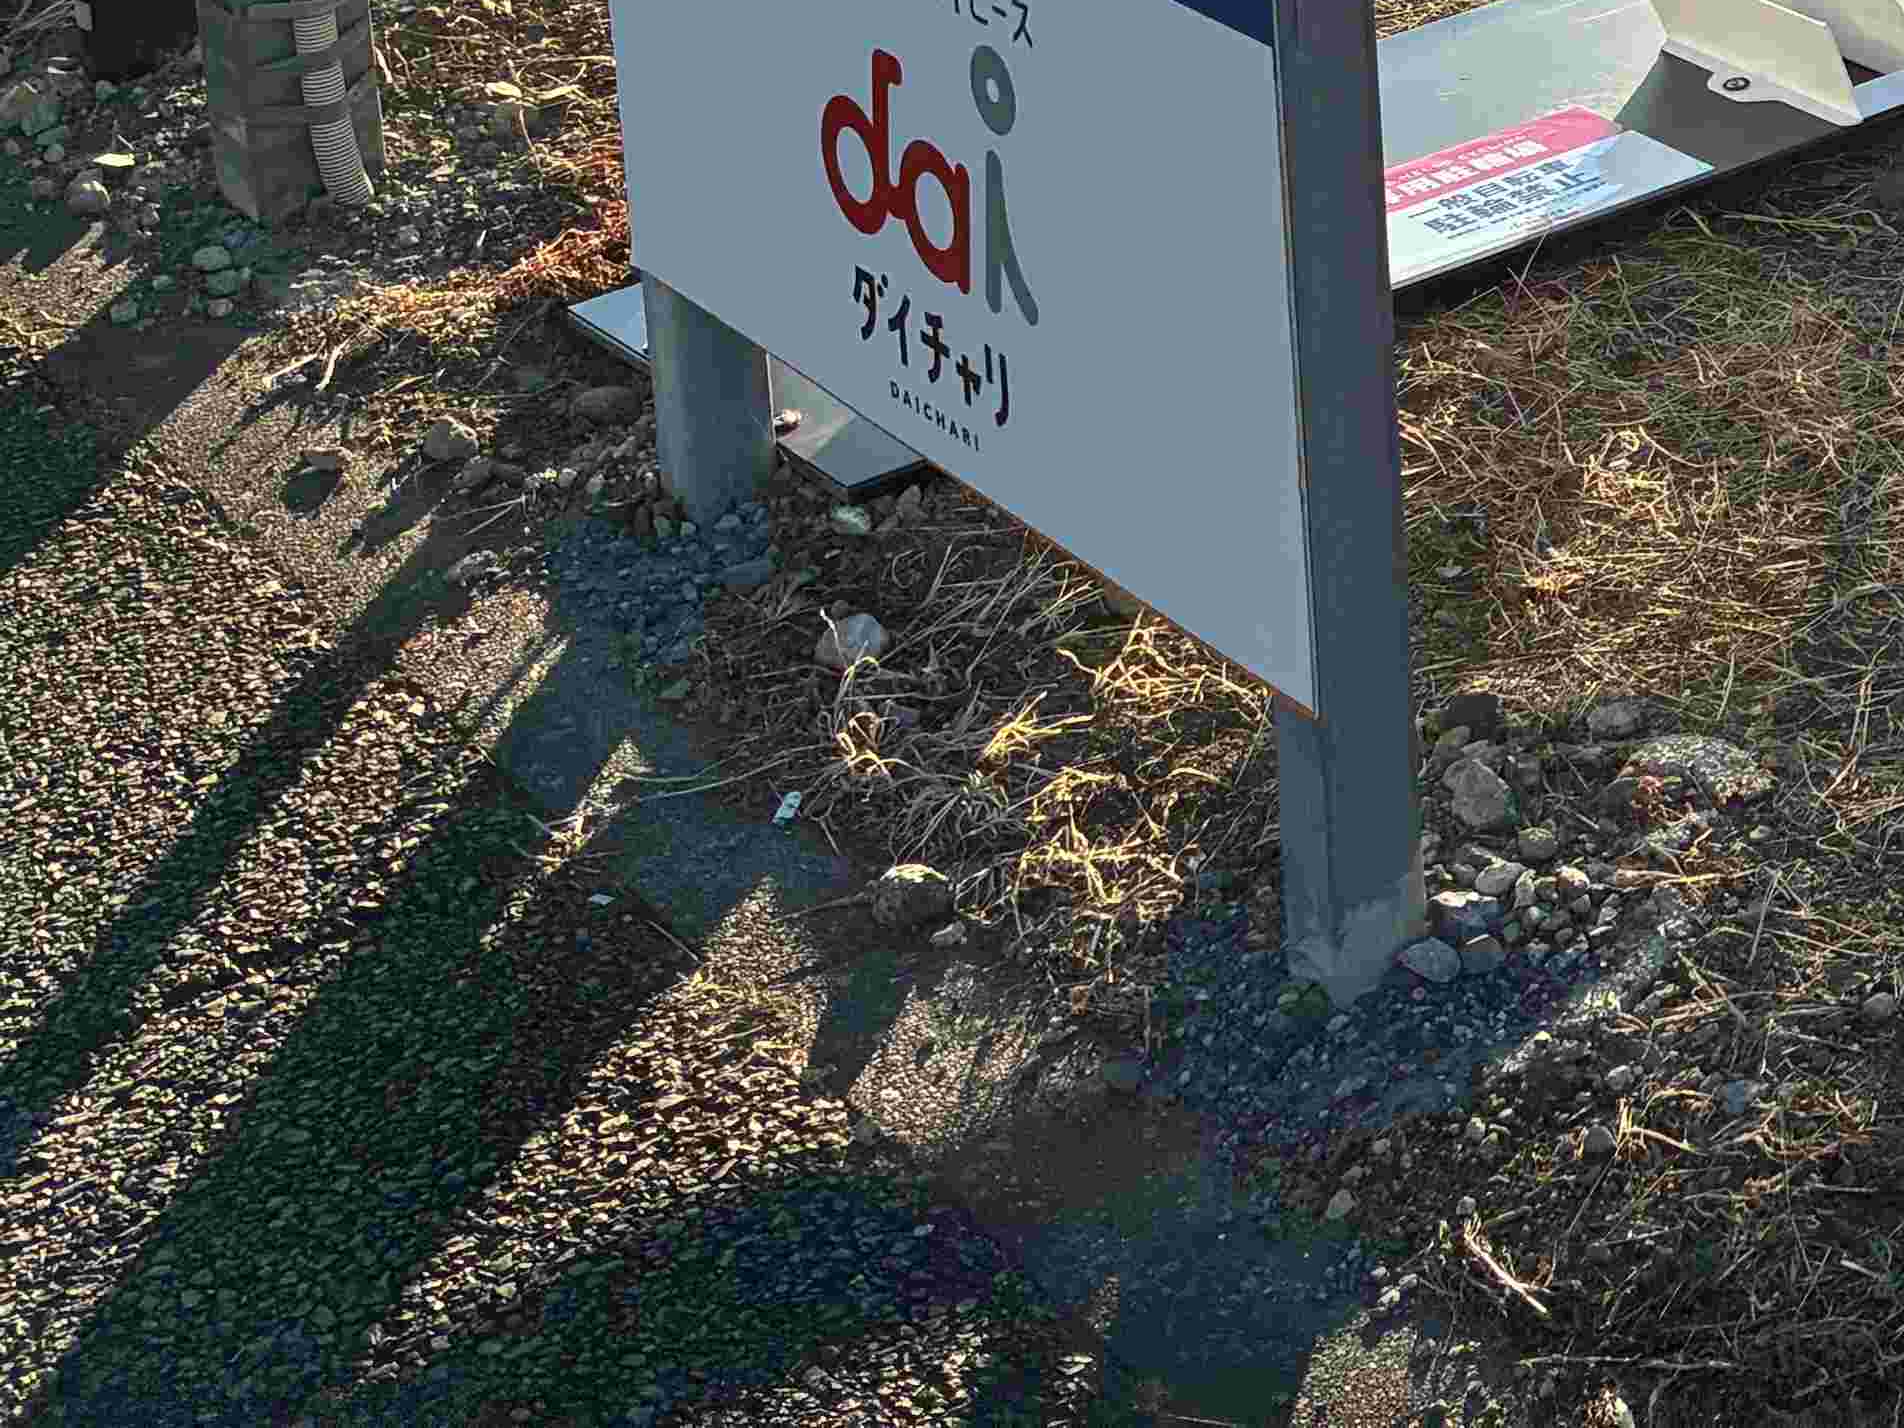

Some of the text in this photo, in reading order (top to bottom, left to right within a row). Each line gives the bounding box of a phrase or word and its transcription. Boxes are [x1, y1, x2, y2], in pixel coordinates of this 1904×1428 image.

[821, 45, 1040, 327] dai
[853, 263, 1010, 428] ダイチャリ
[889, 380, 981, 453] DAICHARI
